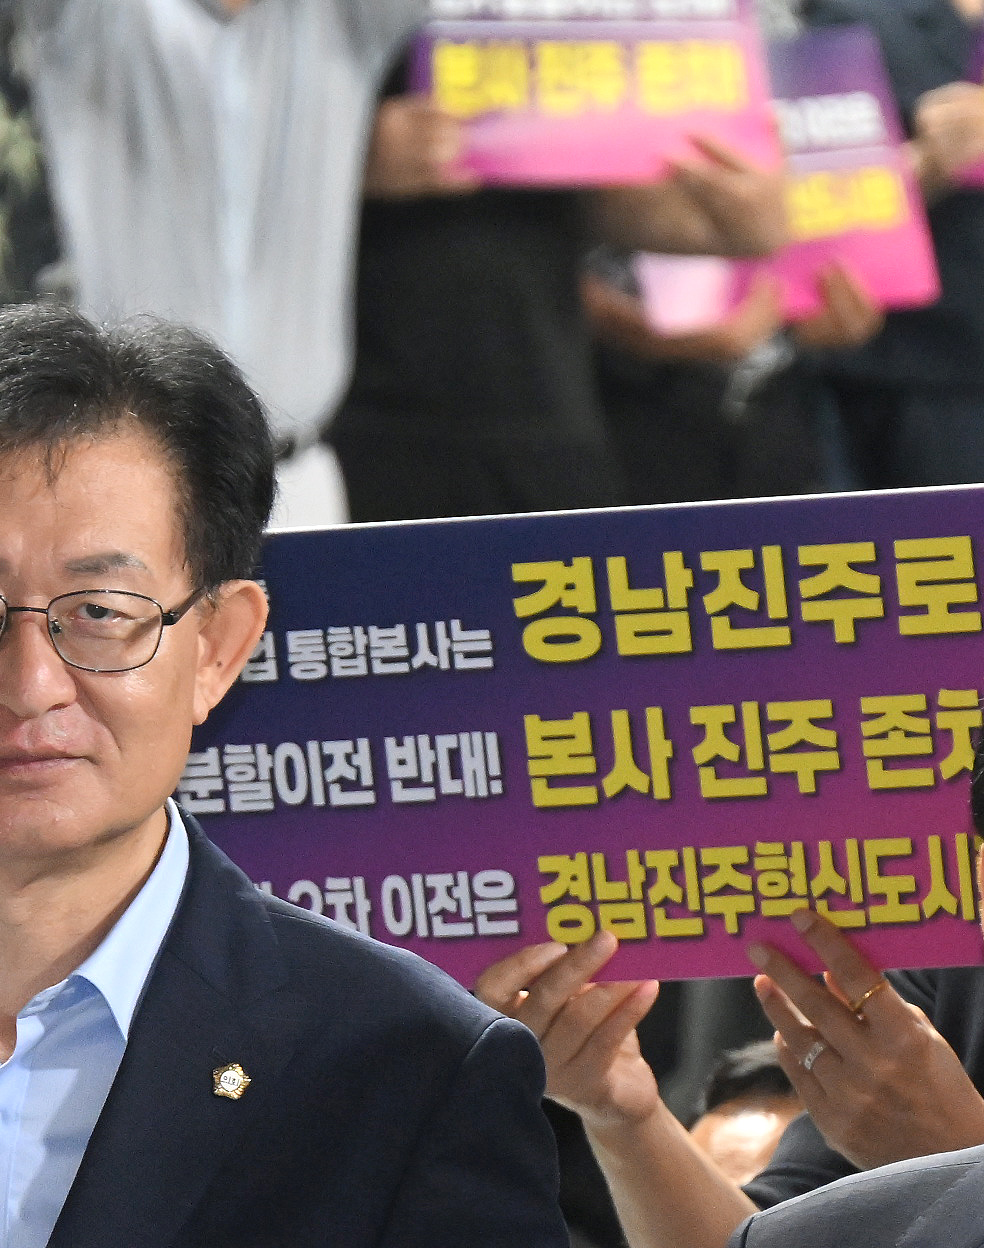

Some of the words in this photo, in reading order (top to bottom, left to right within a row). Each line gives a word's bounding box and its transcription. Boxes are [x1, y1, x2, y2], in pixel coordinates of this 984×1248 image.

[287, 620, 493, 679] 통합본사는
[385, 732, 502, 802] 반대!
[525, 707, 672, 806] 본사
[690, 700, 839, 797] 진주
[381, 870, 519, 937] 이전은
[538, 834, 984, 946] 경남진주혁신도시
